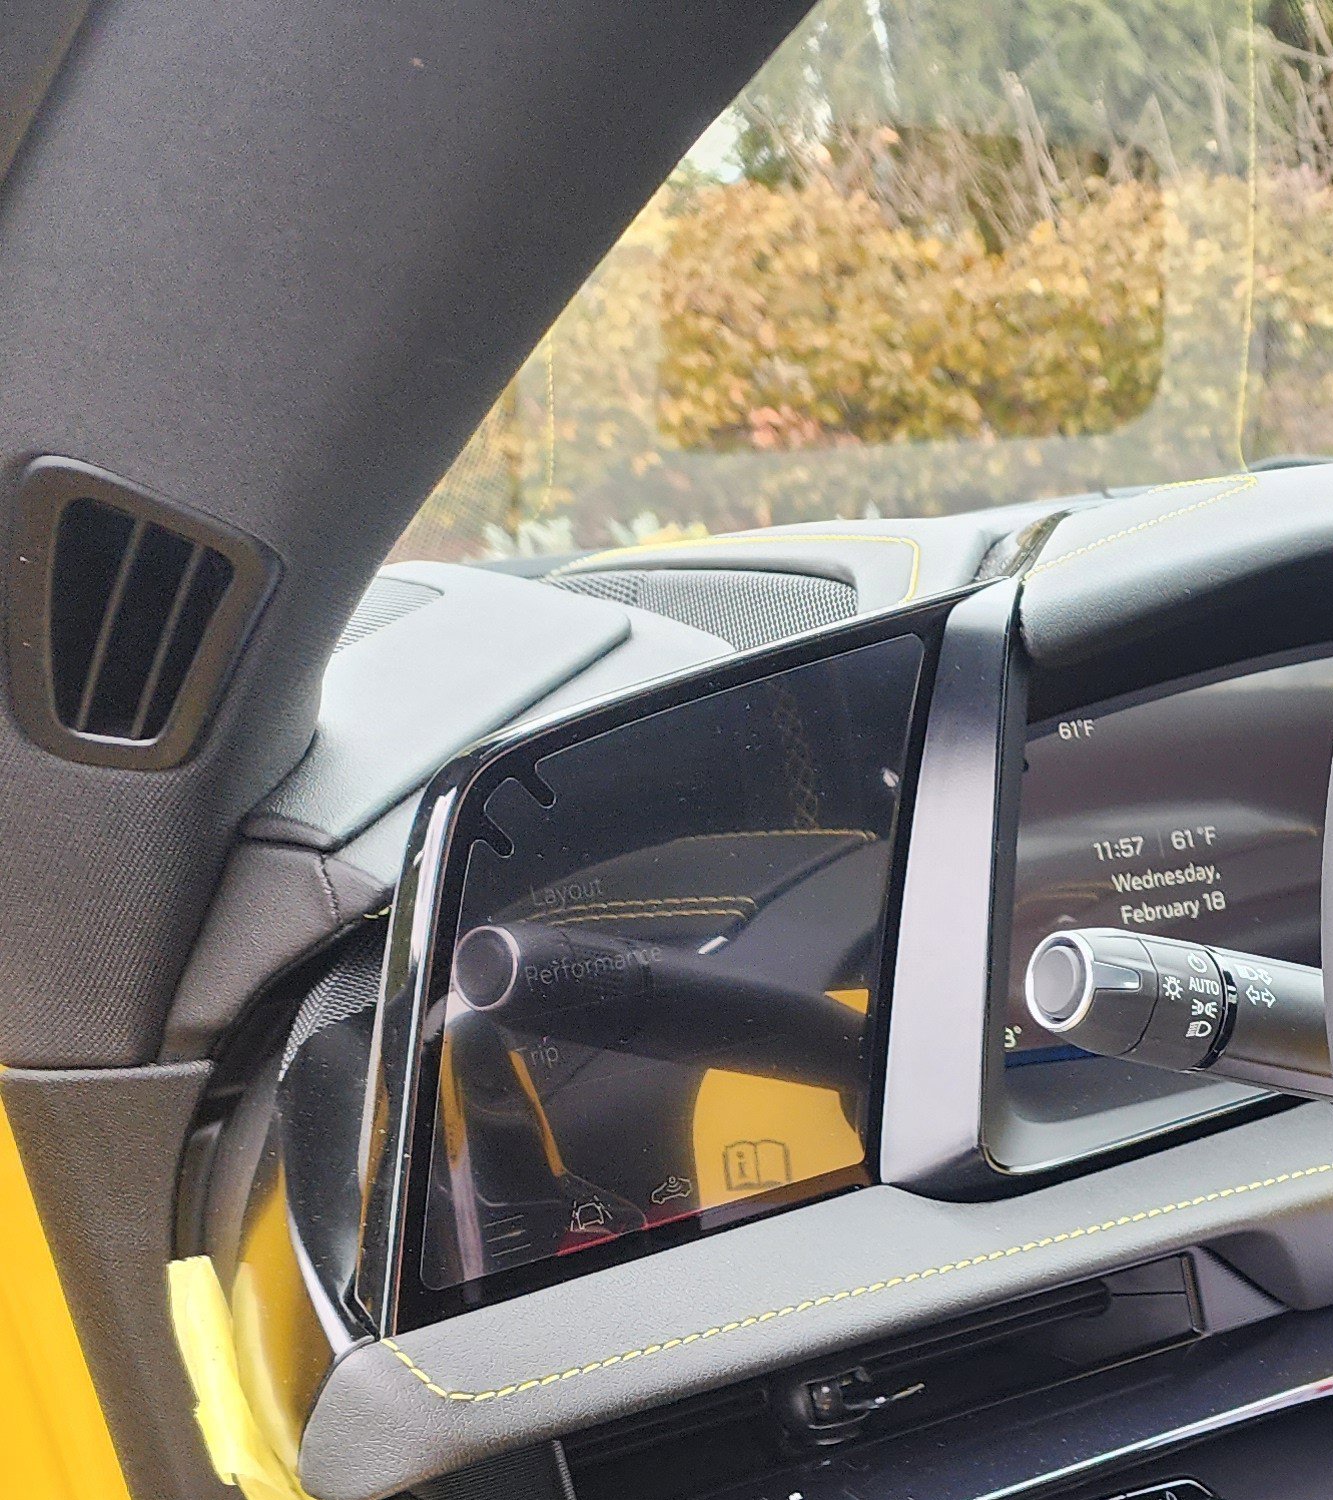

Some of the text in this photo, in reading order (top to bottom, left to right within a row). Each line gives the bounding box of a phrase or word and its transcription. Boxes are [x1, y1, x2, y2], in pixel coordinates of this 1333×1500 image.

[1092, 836, 1144, 862] 11:57
[529, 877, 604, 907] Layout
[1119, 890, 1227, 925] February 18
[524, 946, 662, 987] Performance
[1188, 976, 1220, 996] AUTO
